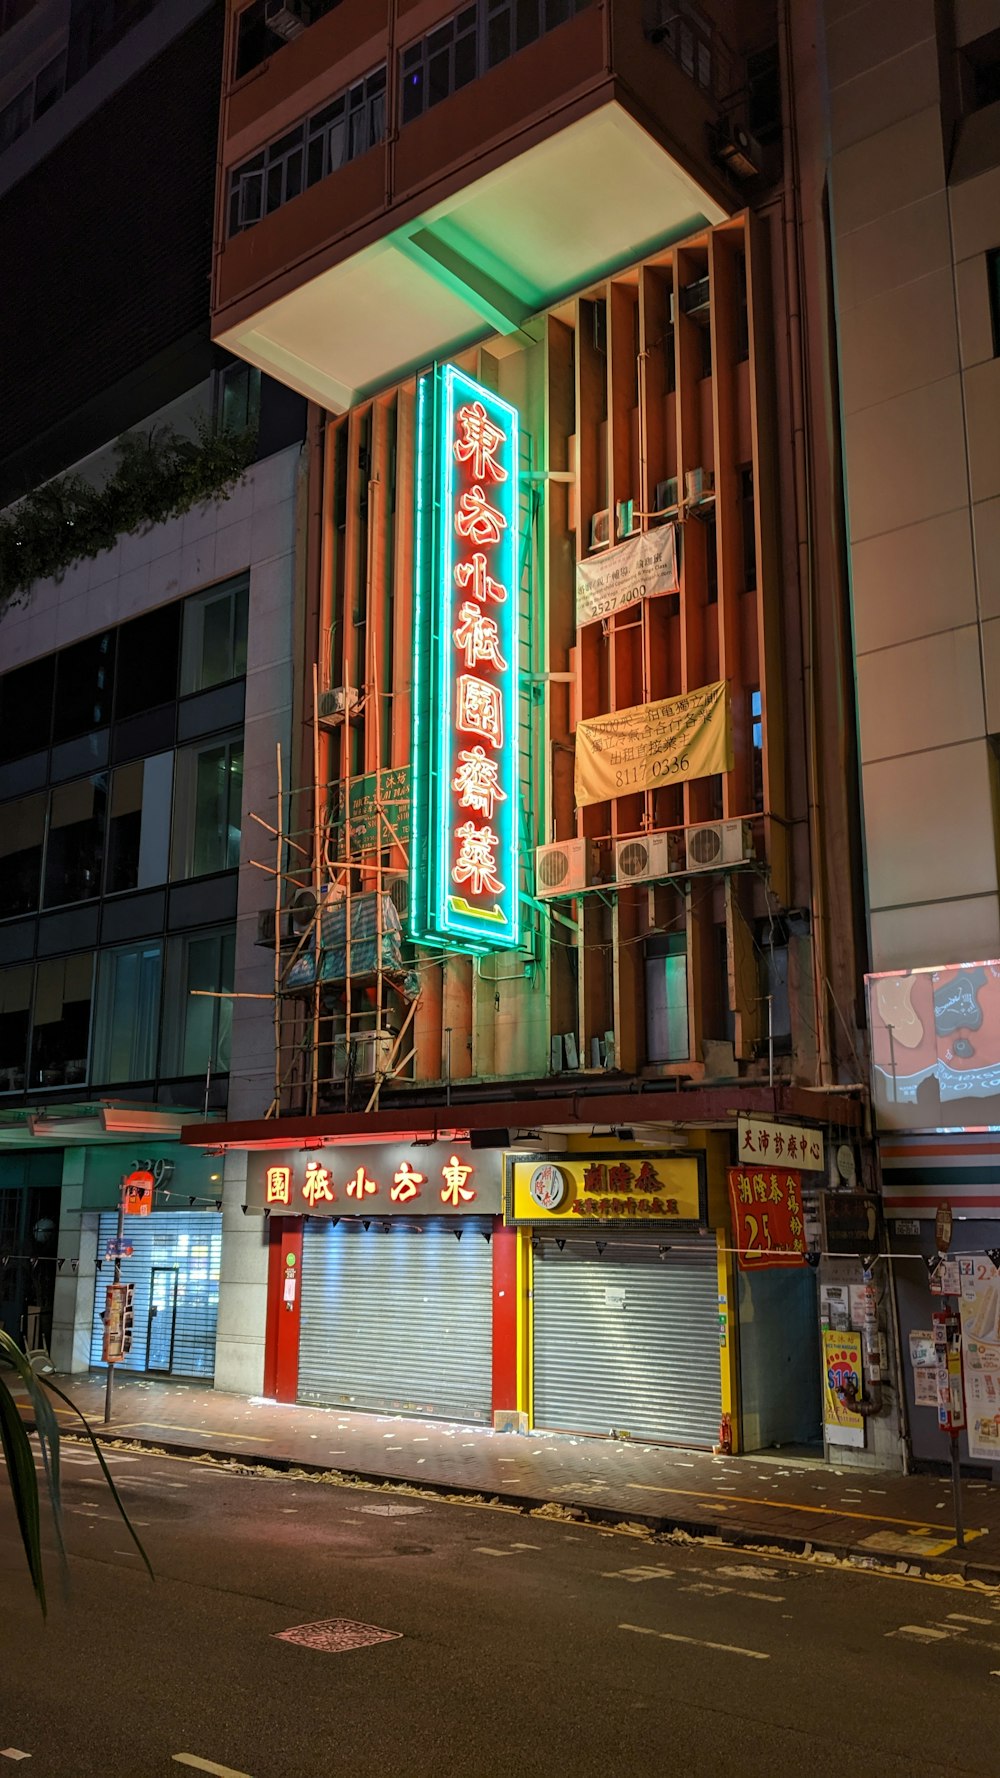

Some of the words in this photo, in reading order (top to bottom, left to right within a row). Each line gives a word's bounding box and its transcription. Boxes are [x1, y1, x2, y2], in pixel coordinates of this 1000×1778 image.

[592, 597, 617, 617] 2527
[620, 584, 647, 605] 4000
[615, 763, 646, 787] 8117
[652, 754, 690, 777] 0336
[737, 1172, 784, 1205] 潮隆泰
